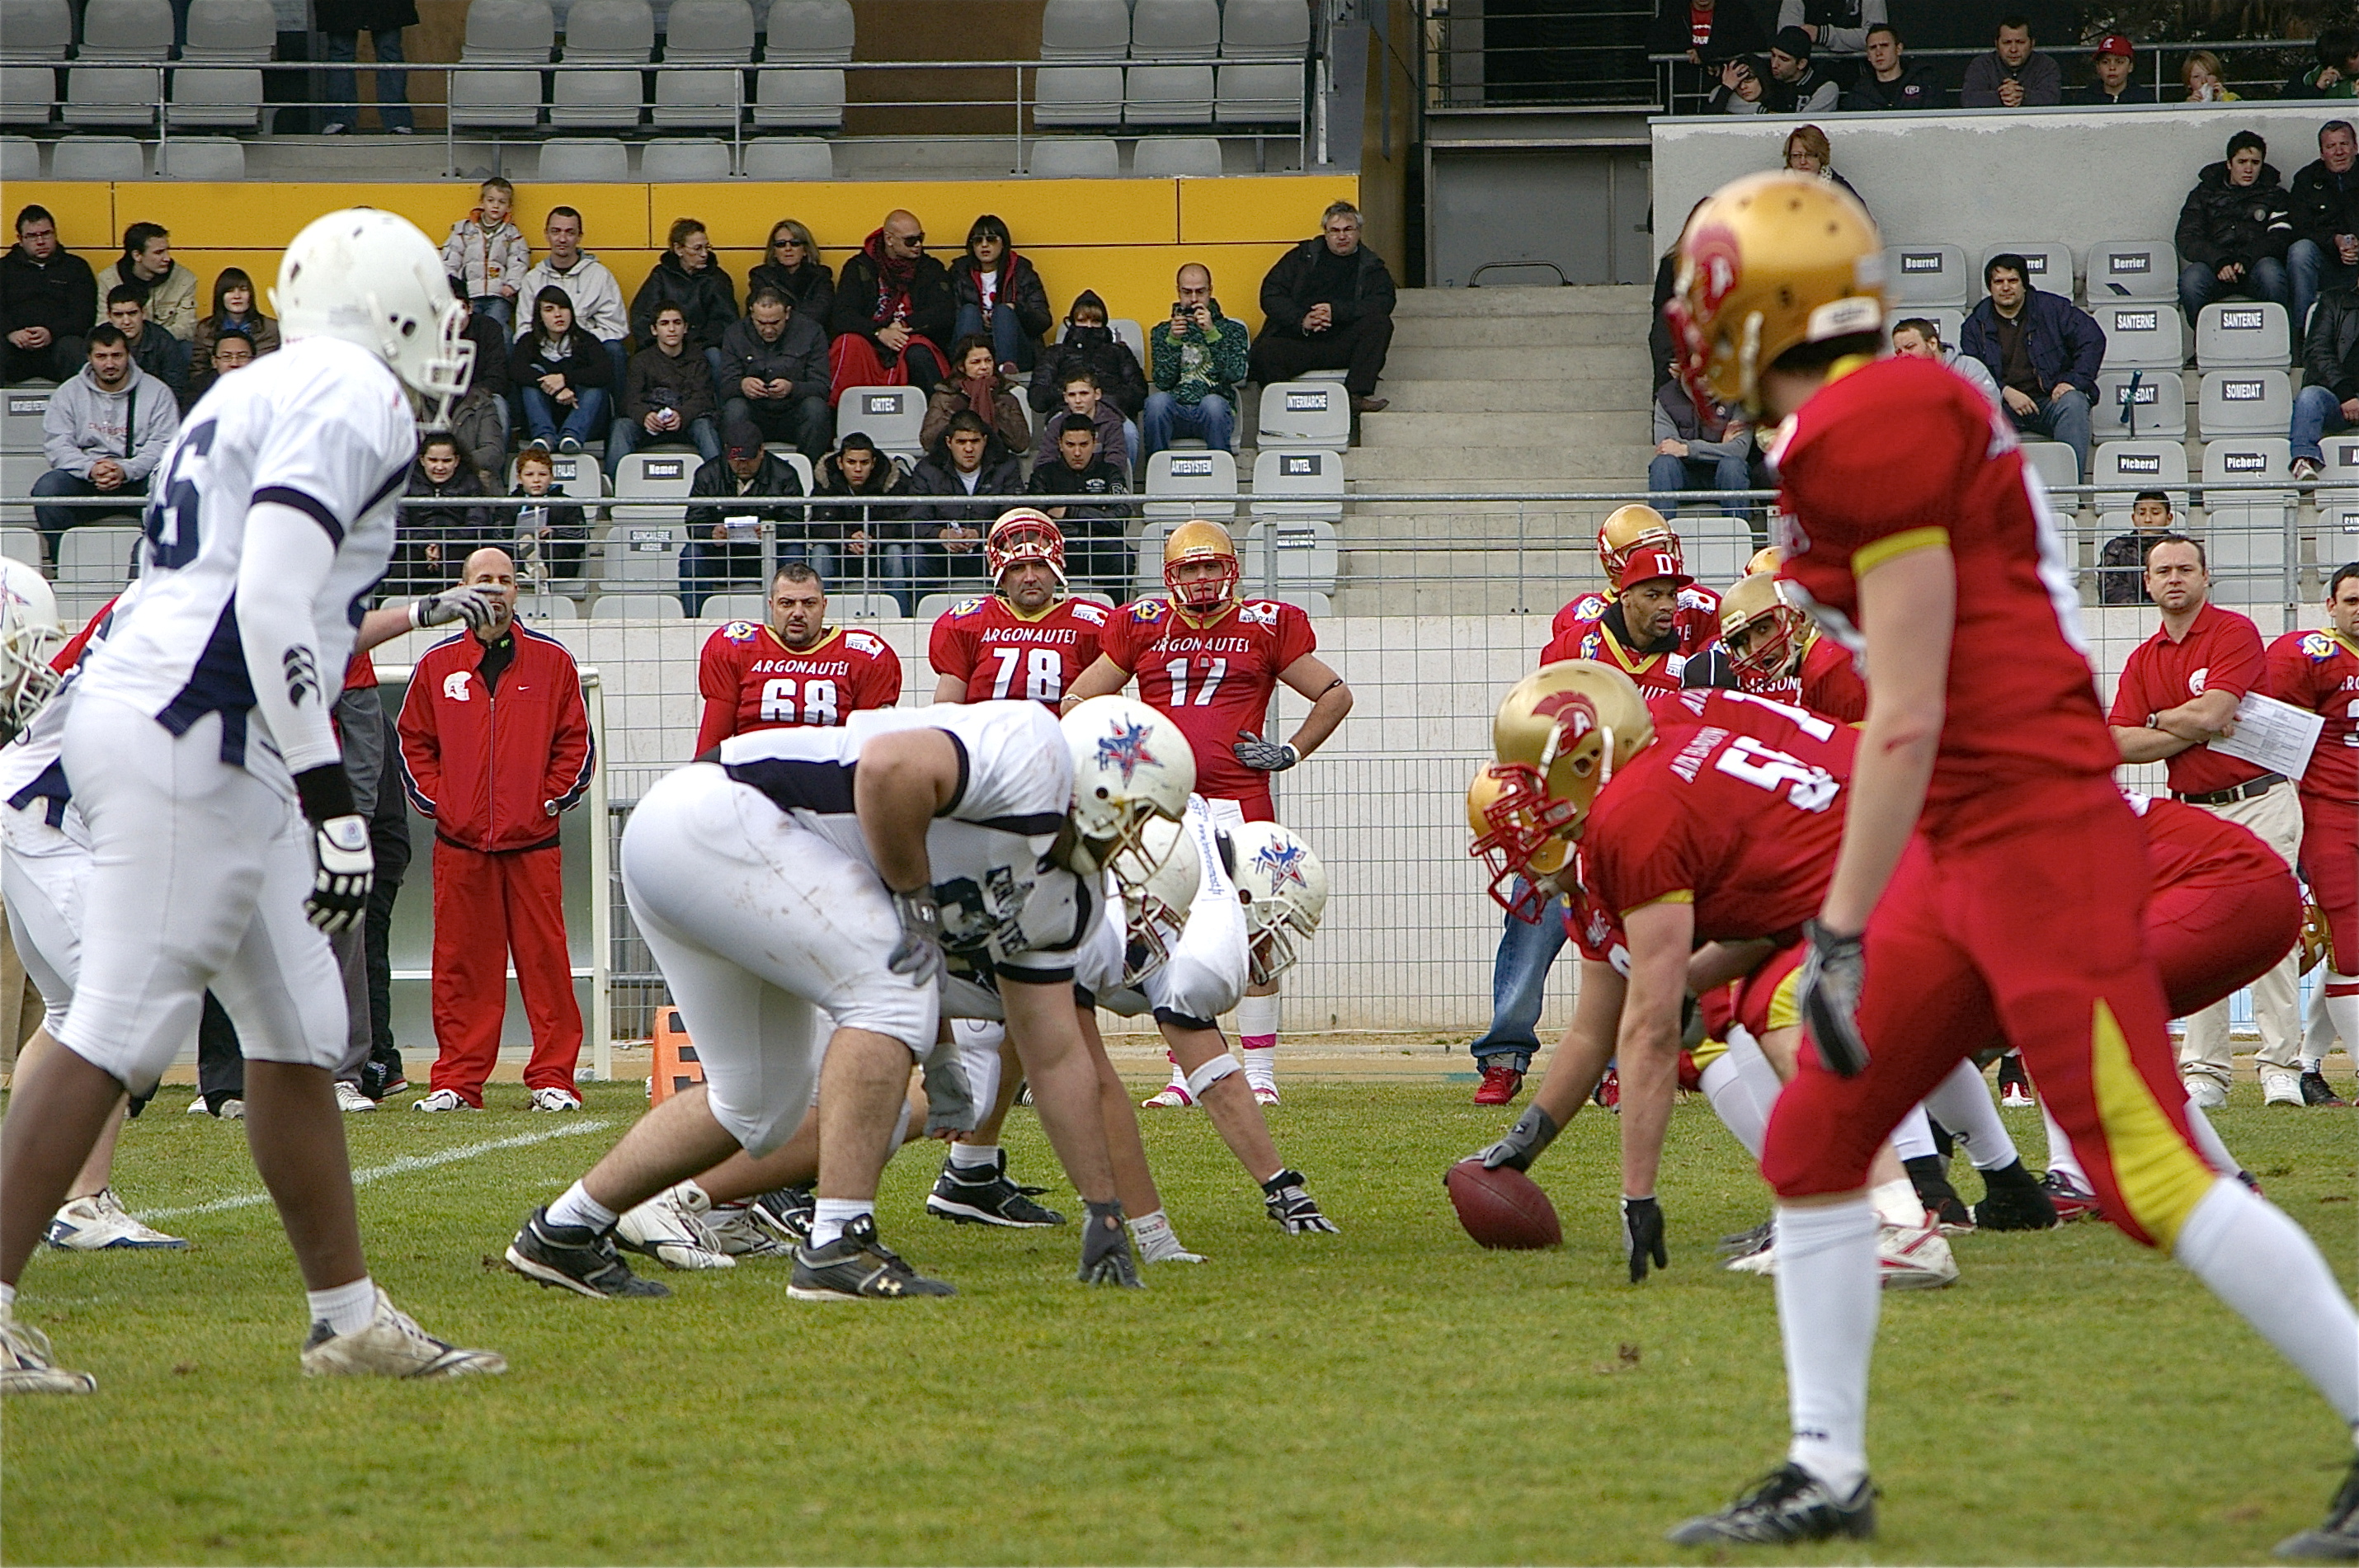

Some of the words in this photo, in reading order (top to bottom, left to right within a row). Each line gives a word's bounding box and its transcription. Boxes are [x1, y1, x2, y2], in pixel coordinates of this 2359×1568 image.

[1905, 257, 1938, 269] Bourrel
[2027, 258, 2043, 270] rrel
[2113, 257, 2146, 269] Berrier
[2117, 313, 2155, 329] SANTERNE
[2223, 312, 2262, 327] SANTERNE
[2120, 388, 2155, 403] SOEDAT
[2226, 384, 2262, 398] SOMEDAT
[871, 398, 895, 412] ORTEC
[1171, 459, 1212, 474] ARTESYSTEM
[1289, 459, 1311, 473] DUTEL
[2121, 459, 2158, 469] Picheral
[2227, 456, 2265, 469] Picheral
[1654, 553, 1674, 575] D
[980, 627, 1077, 645] ARGONAUTES
[1149, 637, 1250, 653] ARGONAUTES
[751, 659, 850, 677] ARGONAUTES
[992, 647, 1062, 702] 78
[1165, 657, 1227, 707] 17
[760, 678, 839, 726] 68
